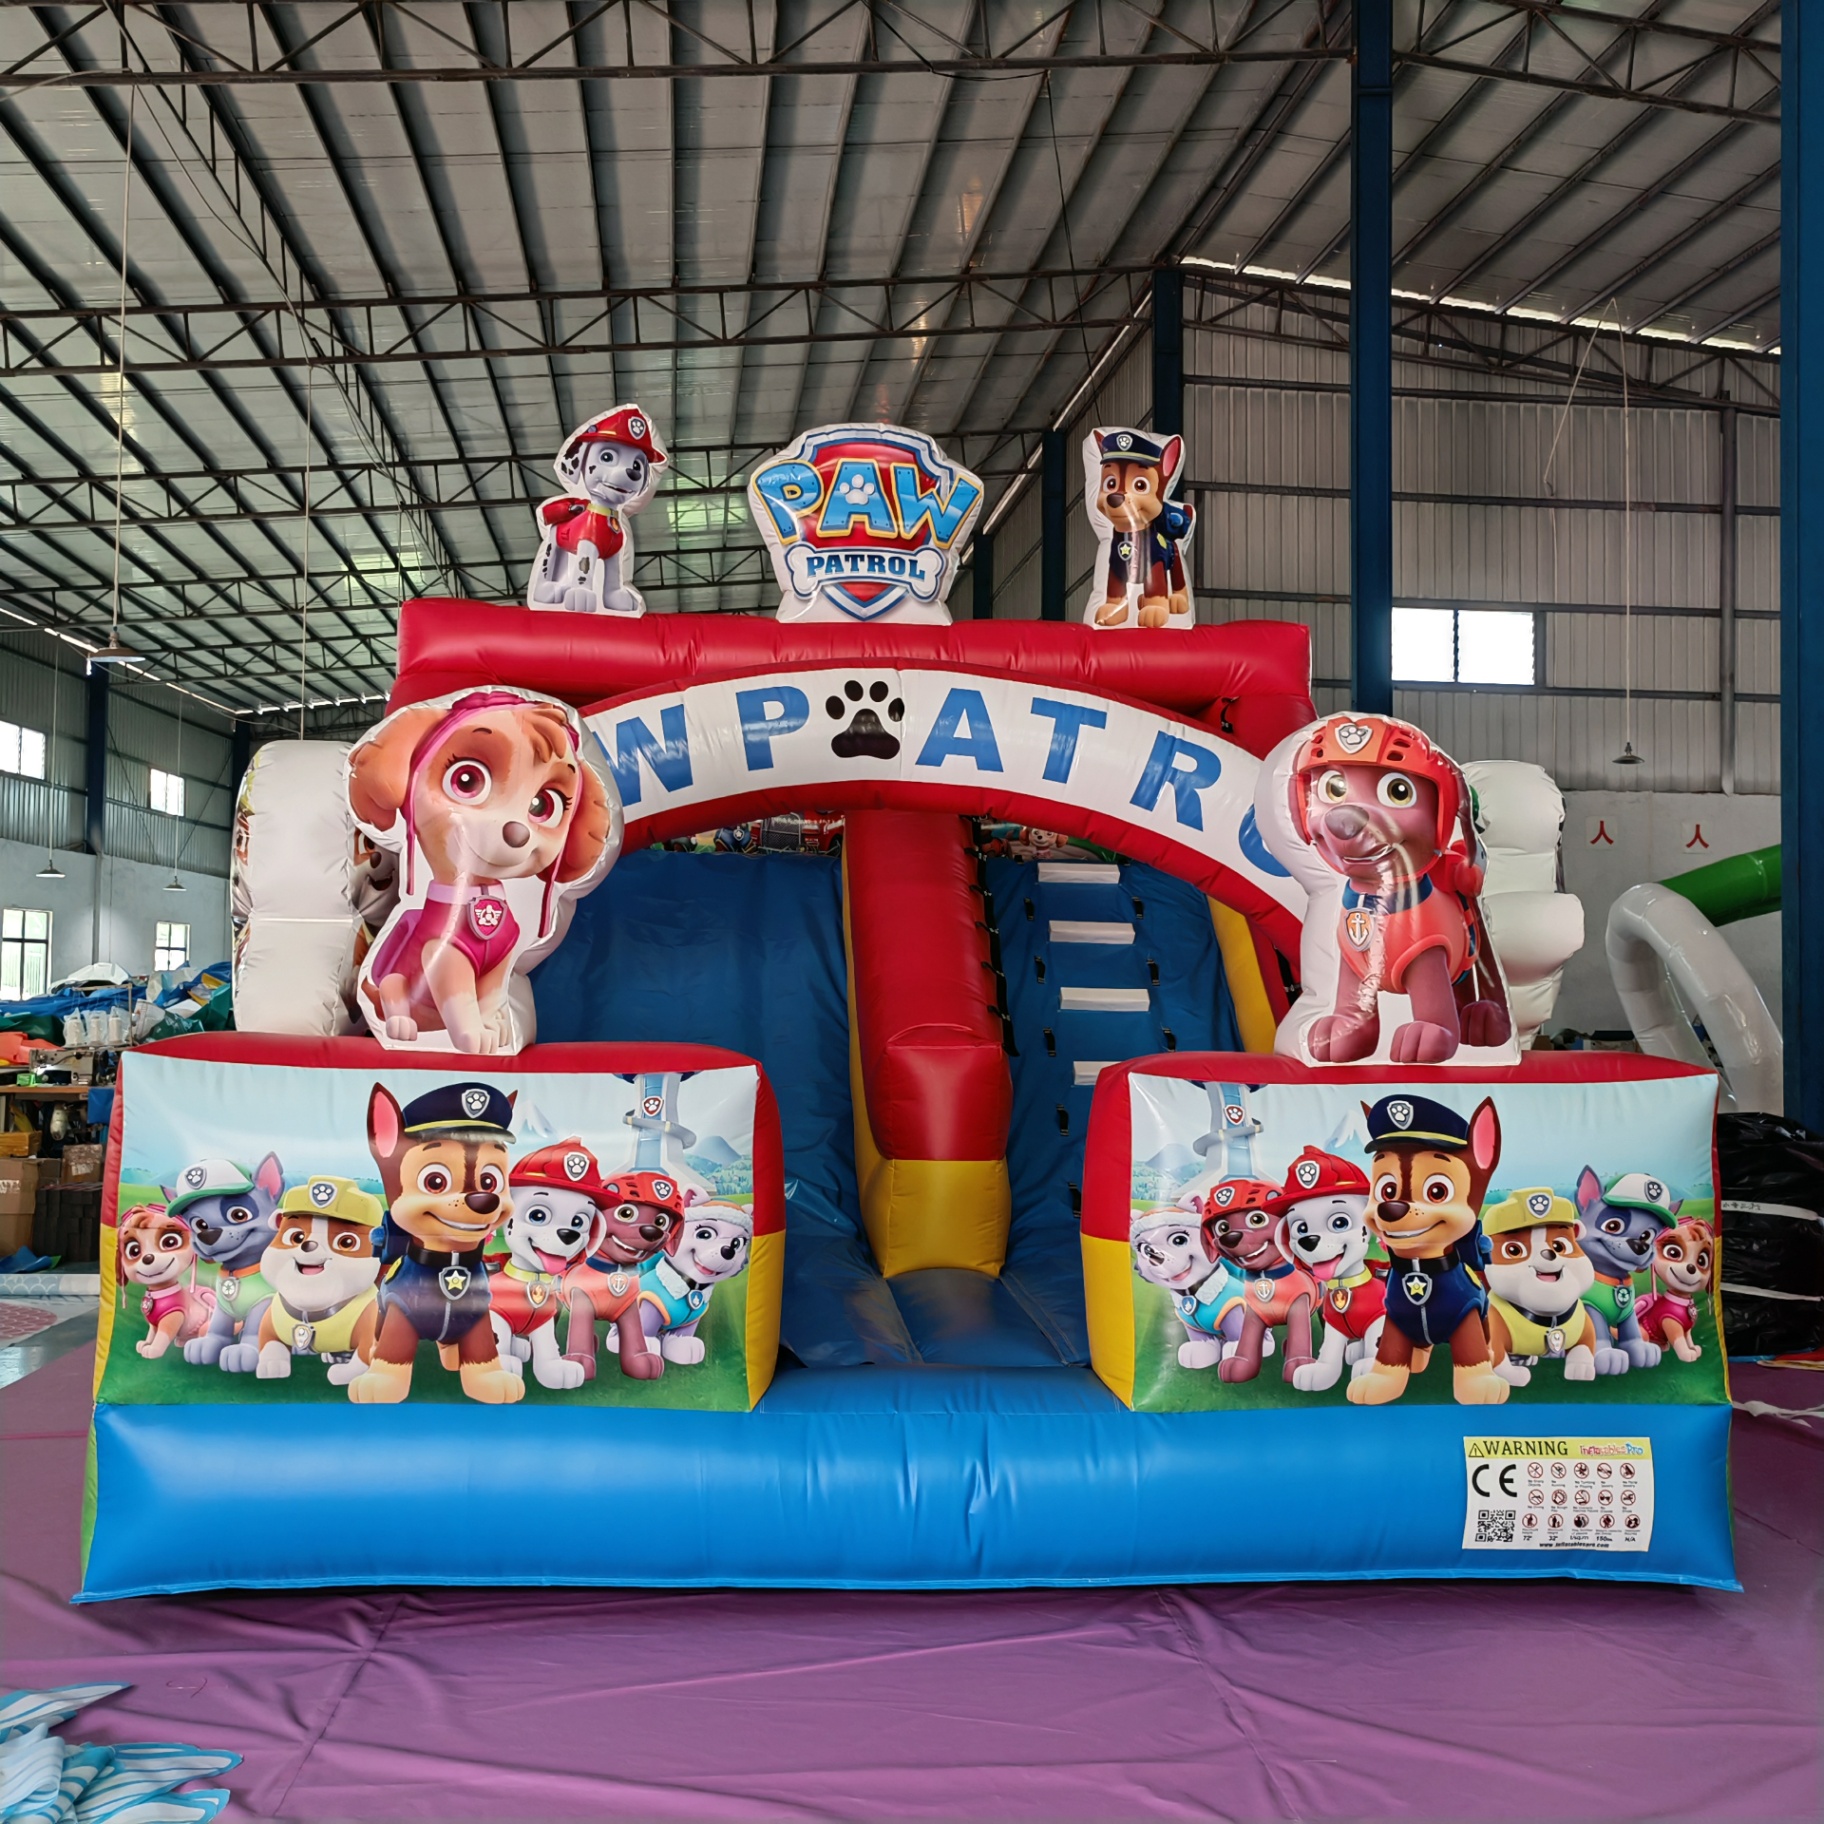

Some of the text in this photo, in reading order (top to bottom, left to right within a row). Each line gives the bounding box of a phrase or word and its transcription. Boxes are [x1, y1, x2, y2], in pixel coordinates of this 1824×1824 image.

[752, 457, 983, 549] PAW
[806, 554, 926, 582] PATROL
[1483, 1441, 1568, 1456] WARNING
